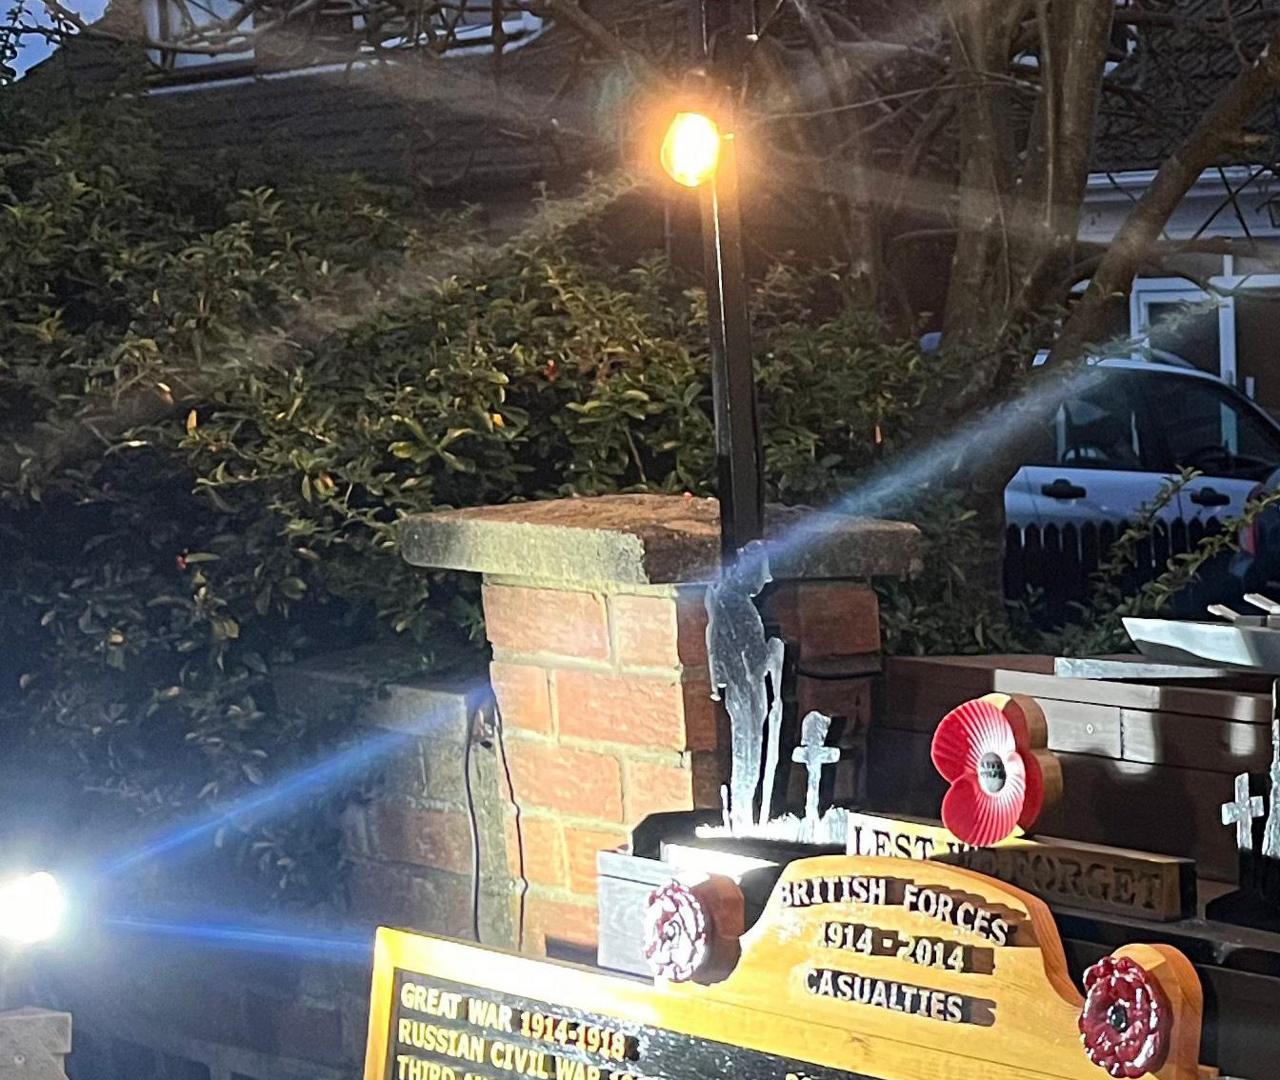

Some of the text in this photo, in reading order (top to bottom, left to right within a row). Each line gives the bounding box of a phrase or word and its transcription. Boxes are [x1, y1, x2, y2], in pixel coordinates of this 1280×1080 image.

[854, 826, 937, 859] LEST
[781, 876, 1008, 947] BRITISH FORCES
[818, 921, 964, 974] 1914 2014
[400, 982, 628, 1061] GREAT WAR 1914-1918
[804, 968, 962, 1023] CASUALTIES
[397, 1019, 485, 1065] RUSSIAN
[490, 1042, 548, 1080] CIVIL
